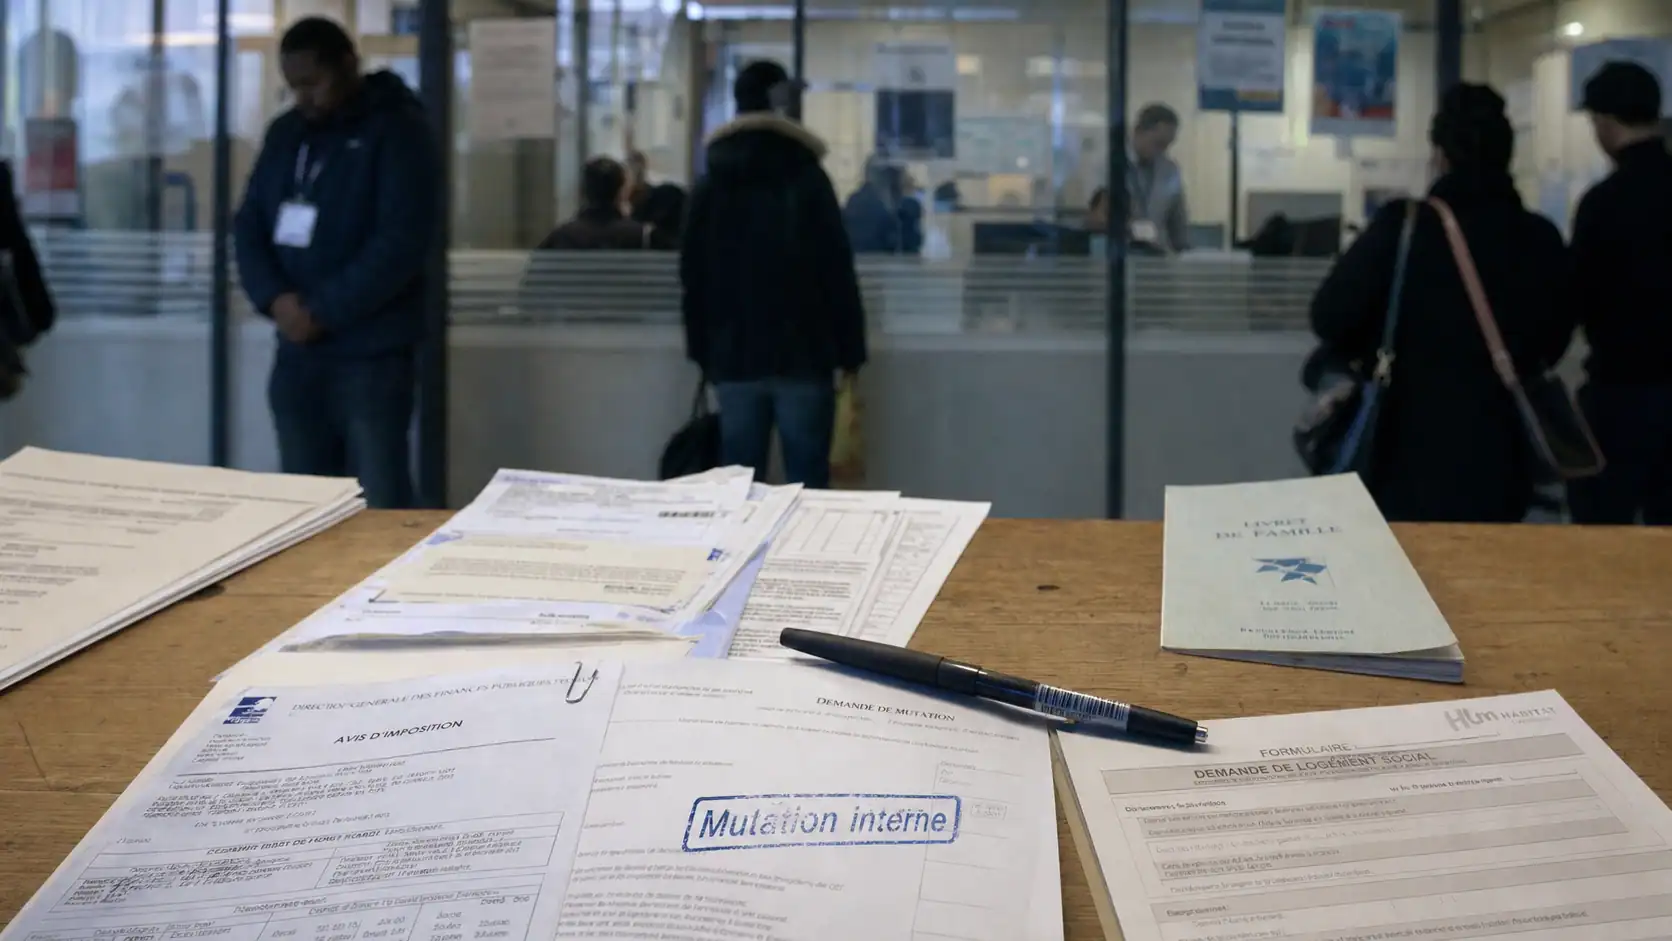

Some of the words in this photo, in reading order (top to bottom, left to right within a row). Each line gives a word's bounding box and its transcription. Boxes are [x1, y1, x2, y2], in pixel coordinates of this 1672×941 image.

[816, 697, 875, 712] DEMANDE
[877, 705, 893, 714] DE
[894, 708, 956, 722] MUTATION
[333, 733, 367, 744] AVIS
[369, 720, 464, 740] D'IMPOSITION
[1259, 743, 1352, 758] FORMULAIRE
[1194, 765, 1270, 779] DEMANDE
[1271, 763, 1294, 773] DE
[1380, 752, 1437, 765] SOCIAL
[699, 805, 838, 838] Mutation
[850, 805, 947, 834] interne
